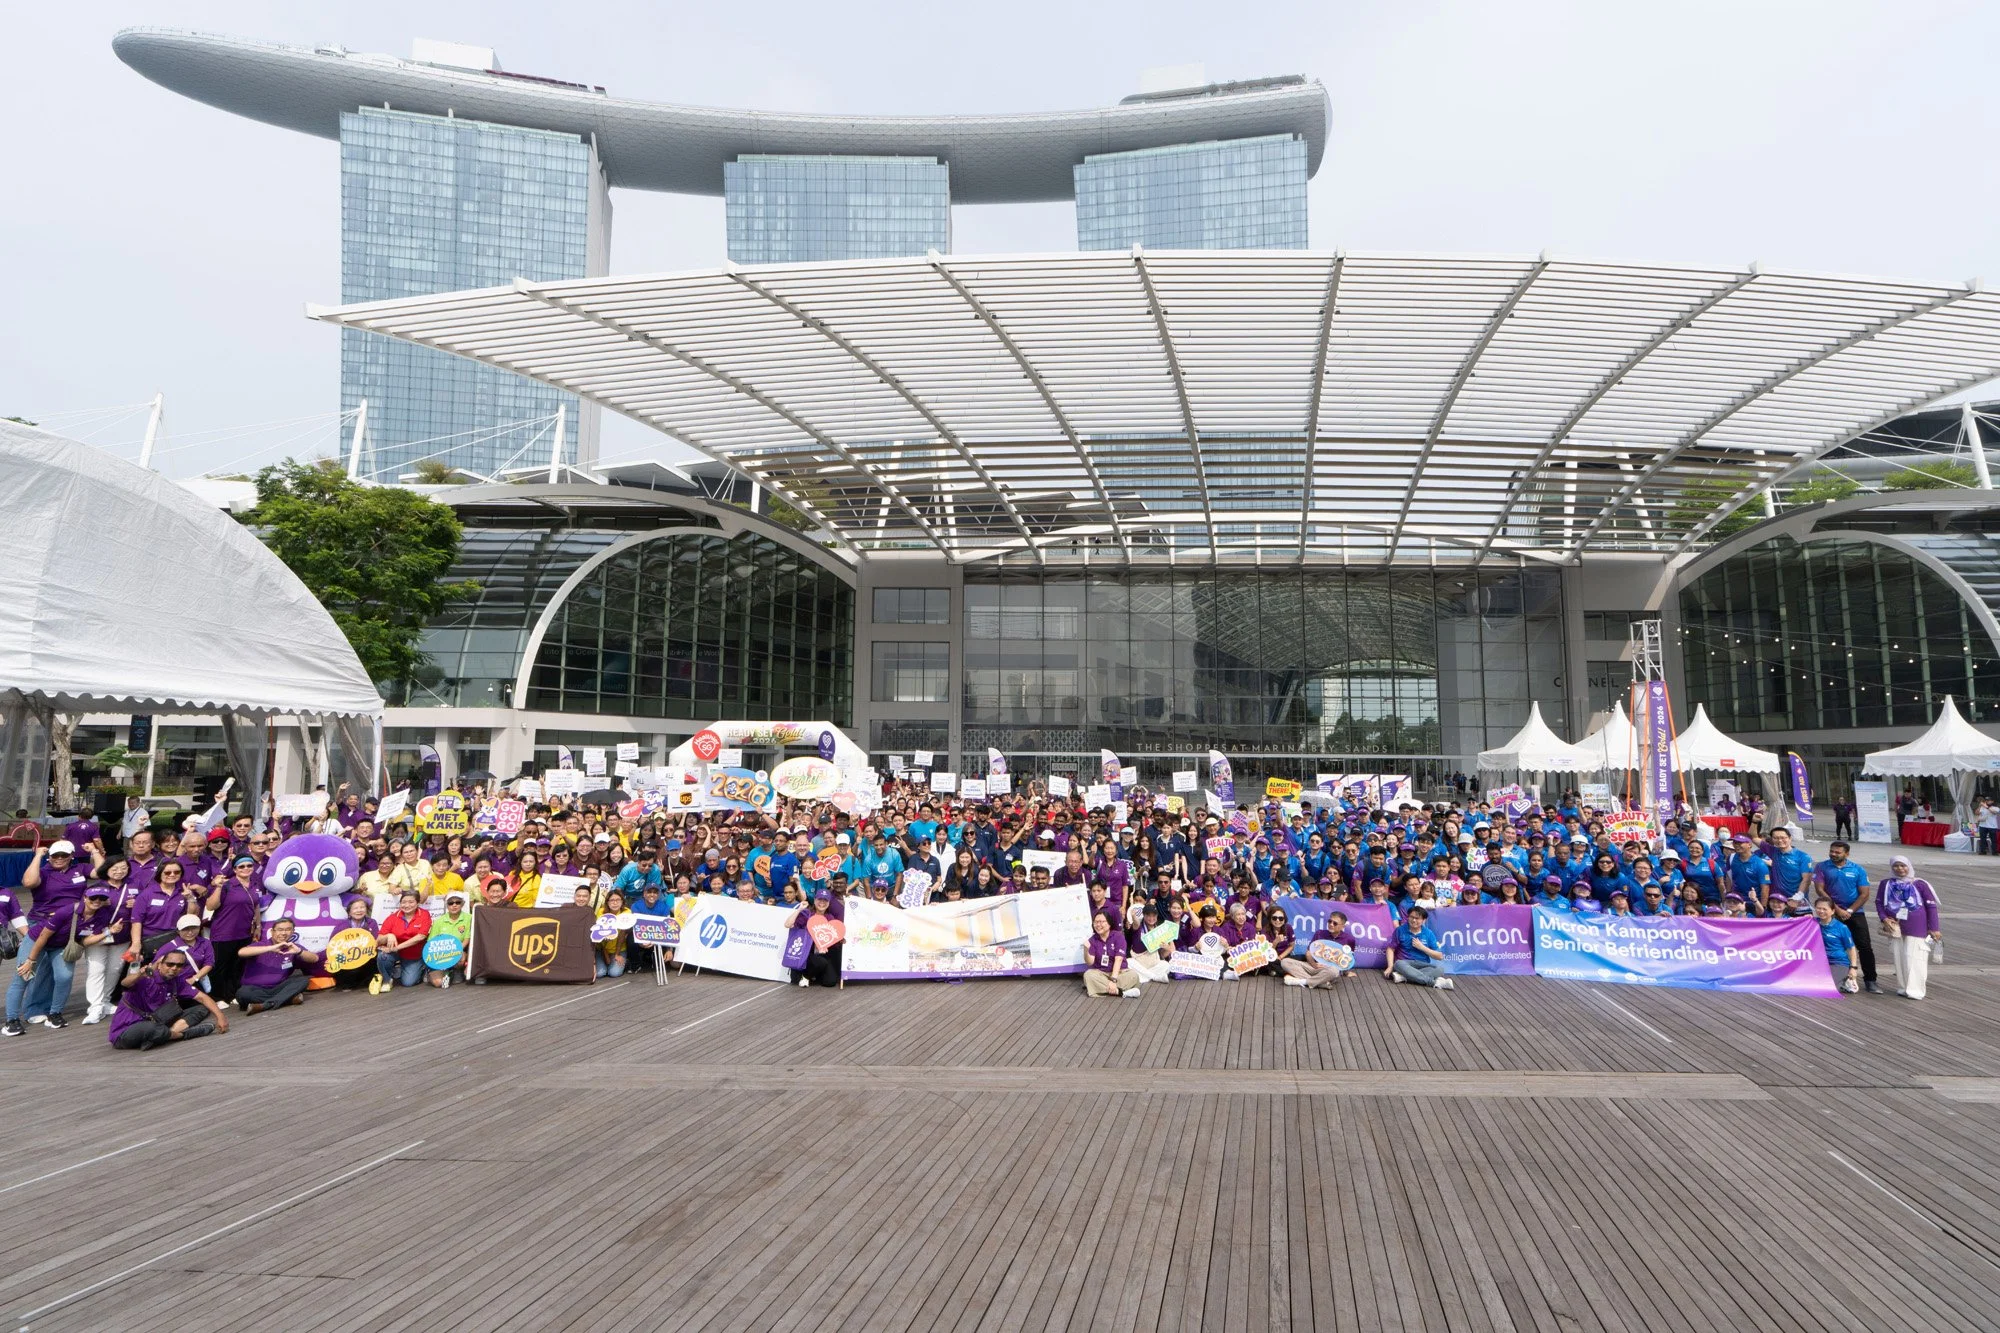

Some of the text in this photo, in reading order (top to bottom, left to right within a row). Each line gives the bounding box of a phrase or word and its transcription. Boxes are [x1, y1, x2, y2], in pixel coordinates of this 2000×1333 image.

[1554, 677, 1619, 688] CNEL
[728, 728, 754, 738] READY
[759, 728, 774, 738] SET
[1167, 744, 1228, 752] SHOPPES
[1232, 744, 1246, 752] AT
[1252, 744, 1304, 752] MARINA
[1345, 745, 1388, 753] SANDS
[1659, 753, 1667, 768] SET
[1660, 768, 1668, 792] READY
[711, 773, 770, 807] 2026
[1800, 786, 1810, 803] FIRST
[680, 796, 692, 804] ups
[501, 802, 522, 812] GO!
[434, 813, 460, 821] MET
[499, 812, 520, 822] GO!
[1606, 812, 1649, 824] BEAUTY
[426, 822, 464, 830] KAKIS
[1610, 830, 1656, 842] SENIOR
[1208, 838, 1234, 848] HEALTH
[1476, 848, 1487, 856] AG
[1470, 862, 1482, 870] LIV
[903, 881, 916, 908] SOCIAL
[636, 924, 666, 932] SOCIAL
[701, 914, 726, 948] hp
[1292, 912, 1388, 942] miron
[1540, 916, 1698, 944] Micron Kampong
[636, 932, 679, 940] COHESION
[731, 928, 777, 941] Singapore Social
[1440, 924, 1528, 947] micron
[430, 938, 456, 947] EVERY
[747, 939, 779, 950] Committee
[348, 946, 374, 962] Day
[428, 944, 457, 953] SENIOR
[514, 933, 554, 964] ups
[1230, 941, 1260, 958] HAPPY
[1540, 934, 1812, 964] Senior Befriending Program
[1172, 952, 1190, 960] ONE
[1314, 942, 1352, 968] 2026
[1443, 952, 1532, 962] telligence Accelerated
[1185, 967, 1218, 978] COMMUNITY
